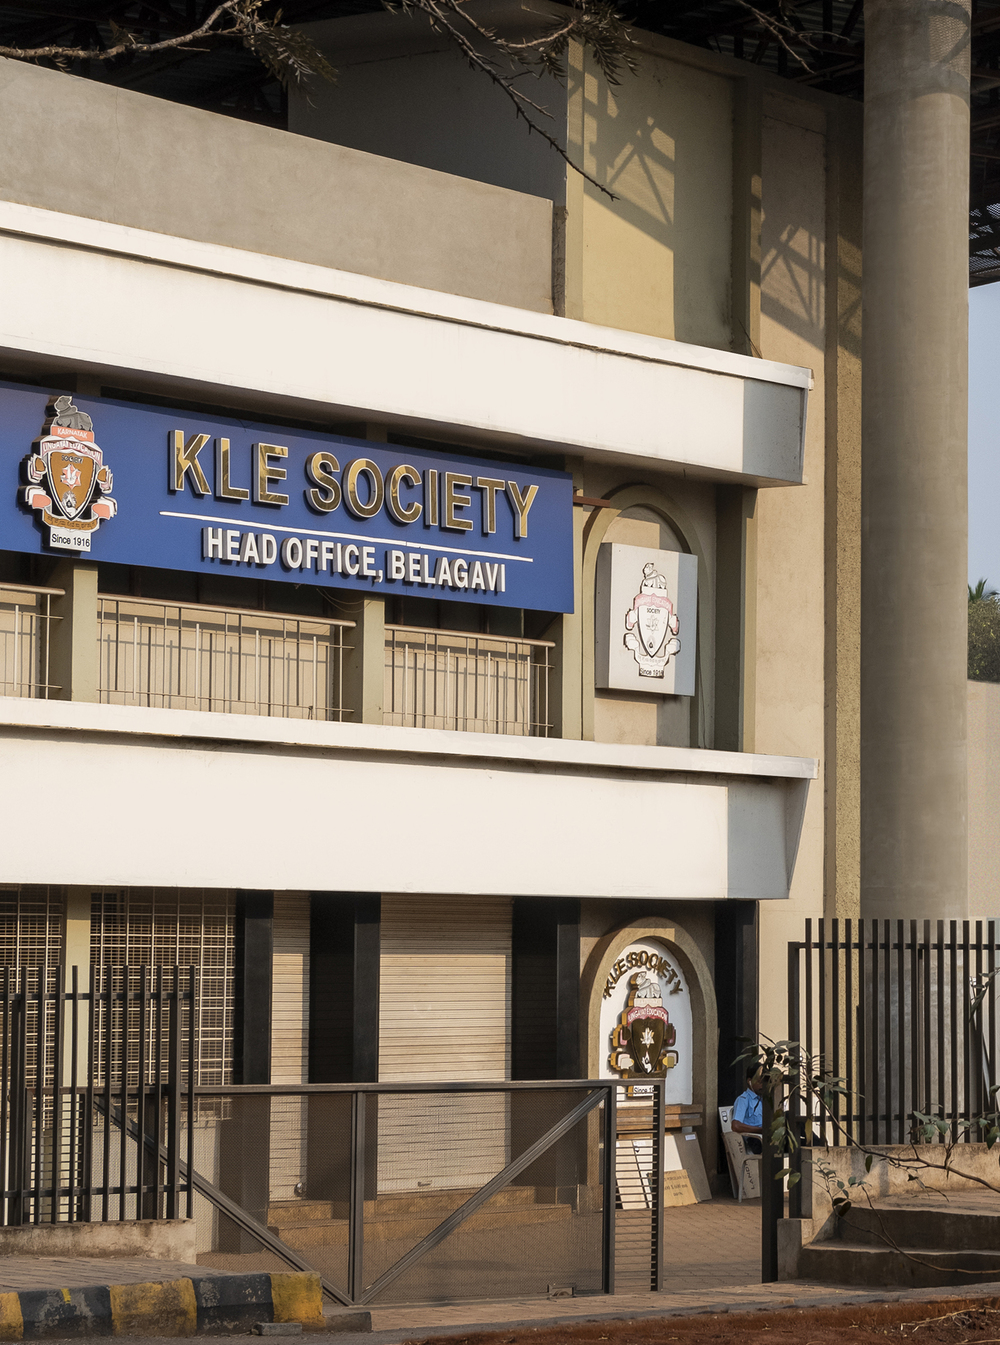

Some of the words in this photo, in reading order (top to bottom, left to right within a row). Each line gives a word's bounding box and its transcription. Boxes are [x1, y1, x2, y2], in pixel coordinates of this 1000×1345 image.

[57, 427, 88, 439] KARNATAK
[61, 455, 84, 464] SOCIETY
[169, 430, 289, 505] KLE
[304, 452, 539, 538] SOCIETY
[51, 533, 71, 545] Since
[73, 537, 91, 547] 1916
[203, 527, 277, 564] HEAD
[282, 537, 383, 583] OFFICE,
[386, 550, 506, 592] BELAGAVI
[629, 950, 683, 995] SOCIETY
